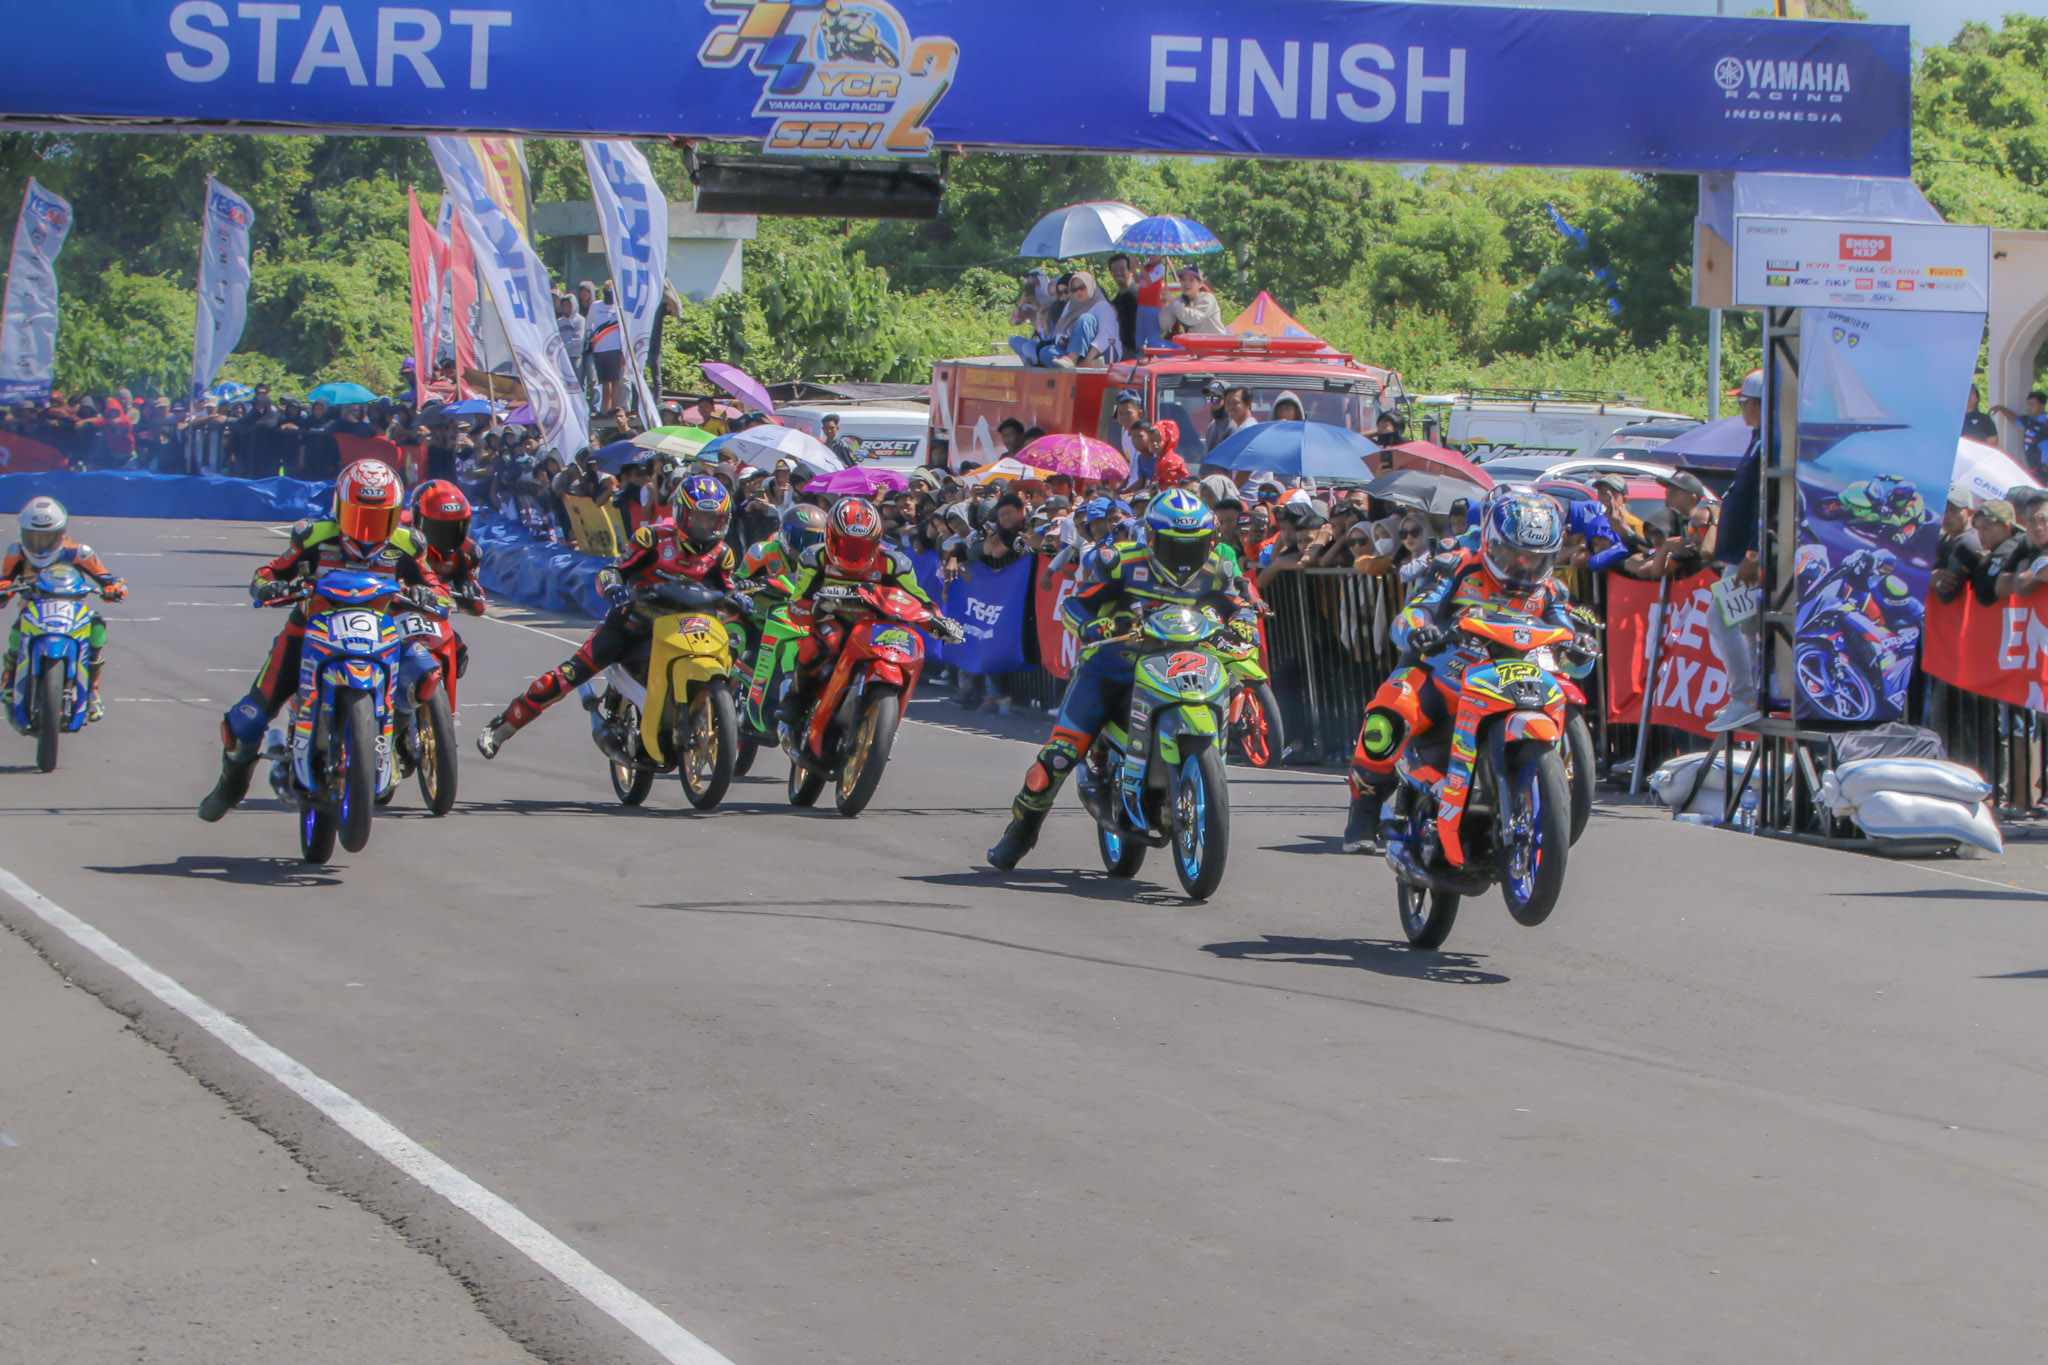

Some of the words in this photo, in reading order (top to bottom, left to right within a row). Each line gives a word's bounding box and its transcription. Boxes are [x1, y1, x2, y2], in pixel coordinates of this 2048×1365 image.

[166, 1, 512, 89] START
[1149, 36, 1467, 126] FINISH
[1745, 59, 1850, 92] YAMAHA
[818, 72, 902, 97] YCR
[769, 121, 885, 149] SERI
[882, 37, 958, 151] 2
[1725, 90, 1843, 102] RACING
[769, 101, 822, 111] YAMAHA
[824, 102, 850, 111] CUP
[851, 103, 886, 112] RACE
[1725, 109, 1842, 122] INDONESIA
[1845, 238, 1885, 250] ENEOS
[1852, 248, 1878, 258] NXP
[861, 441, 917, 450] ROKET
[442, 503, 461, 512] KYT
[1174, 518, 1198, 527] KYT
[847, 526, 868, 534] Arai
[1519, 528, 1548, 543] Arai
[342, 614, 372, 632] 16
[400, 616, 437, 635] 139
[1167, 651, 1208, 679] 22
